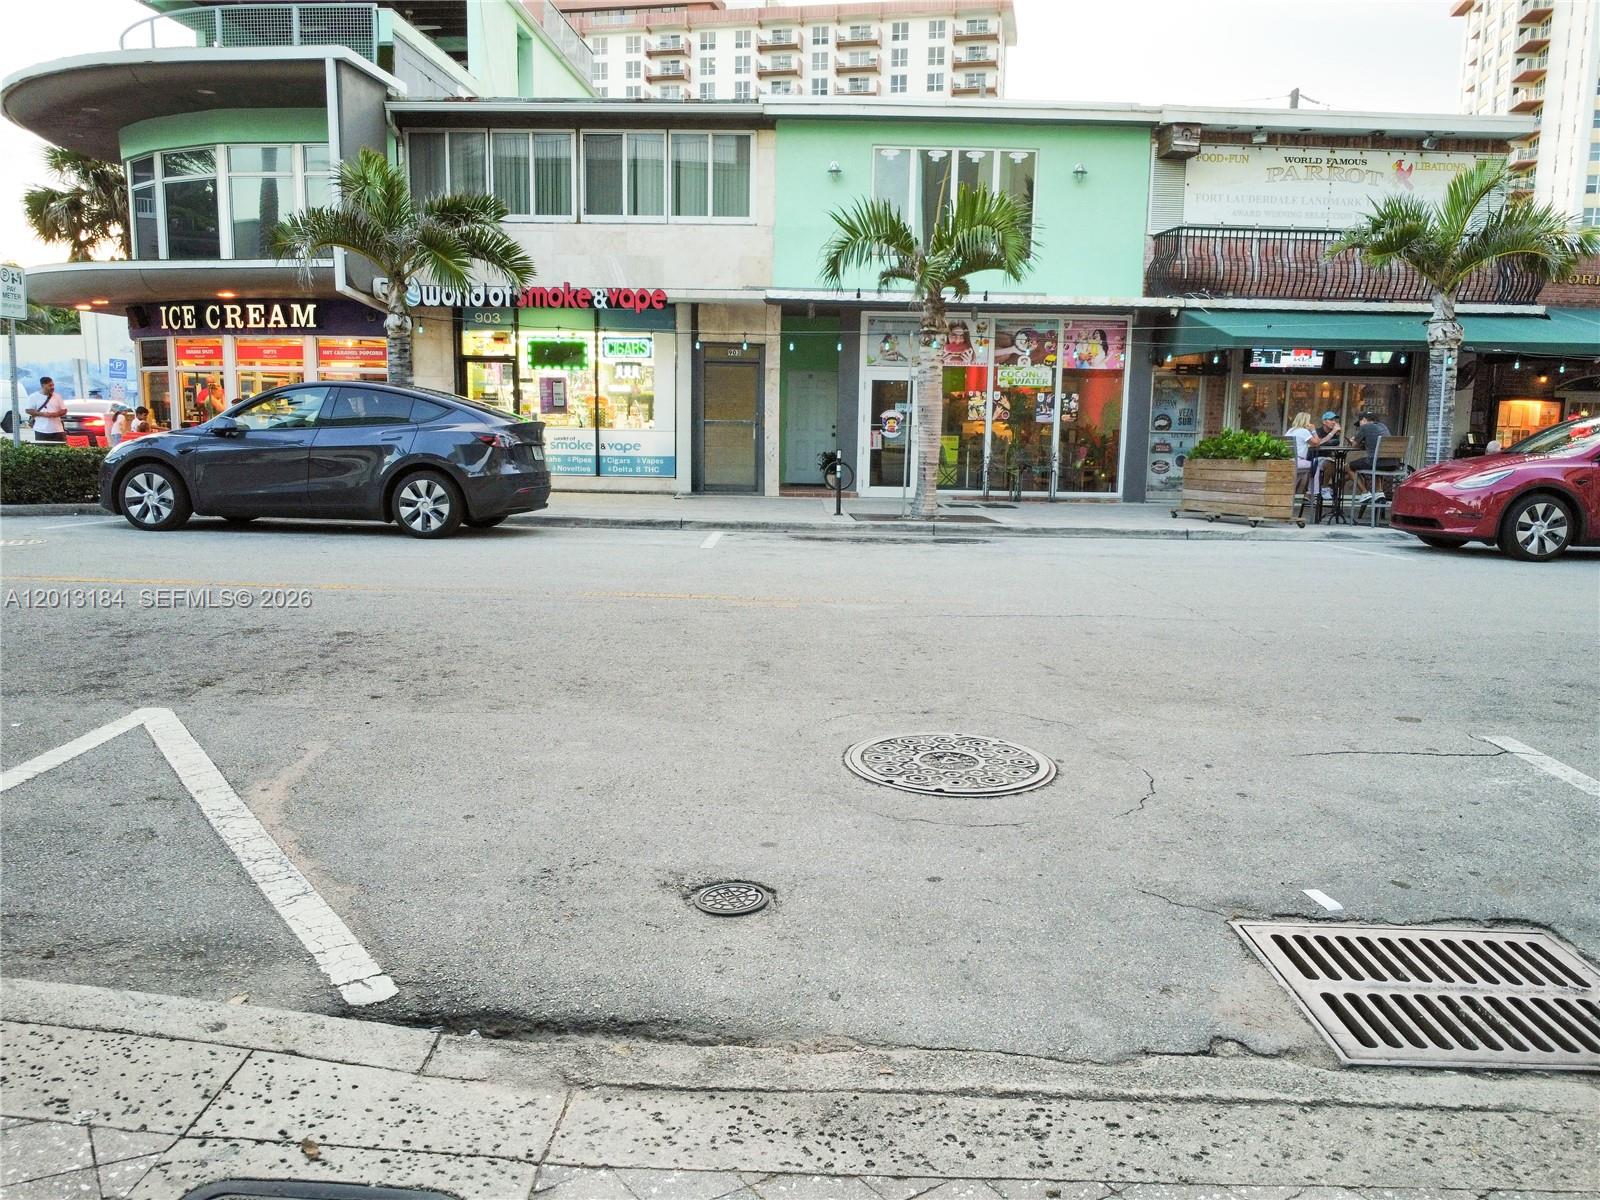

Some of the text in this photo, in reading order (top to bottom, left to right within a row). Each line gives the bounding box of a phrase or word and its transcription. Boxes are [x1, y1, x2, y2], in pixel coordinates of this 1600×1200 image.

[1284, 156, 1368, 166] WORLD FAMOUS
[1265, 164, 1384, 187] PARROT
[2, 292, 21, 300] METER
[422, 282, 667, 314] world of smoke & vape
[160, 304, 317, 330] ICE CREAM
[474, 313, 501, 324] 903
[606, 341, 648, 356] CIGARS
[550, 440, 594, 450] smoke
[607, 442, 642, 453] vape
[606, 457, 631, 465] Cigars
[641, 458, 664, 466] Vapes
[556, 465, 591, 473] Novelties
[643, 467, 660, 475] THC
